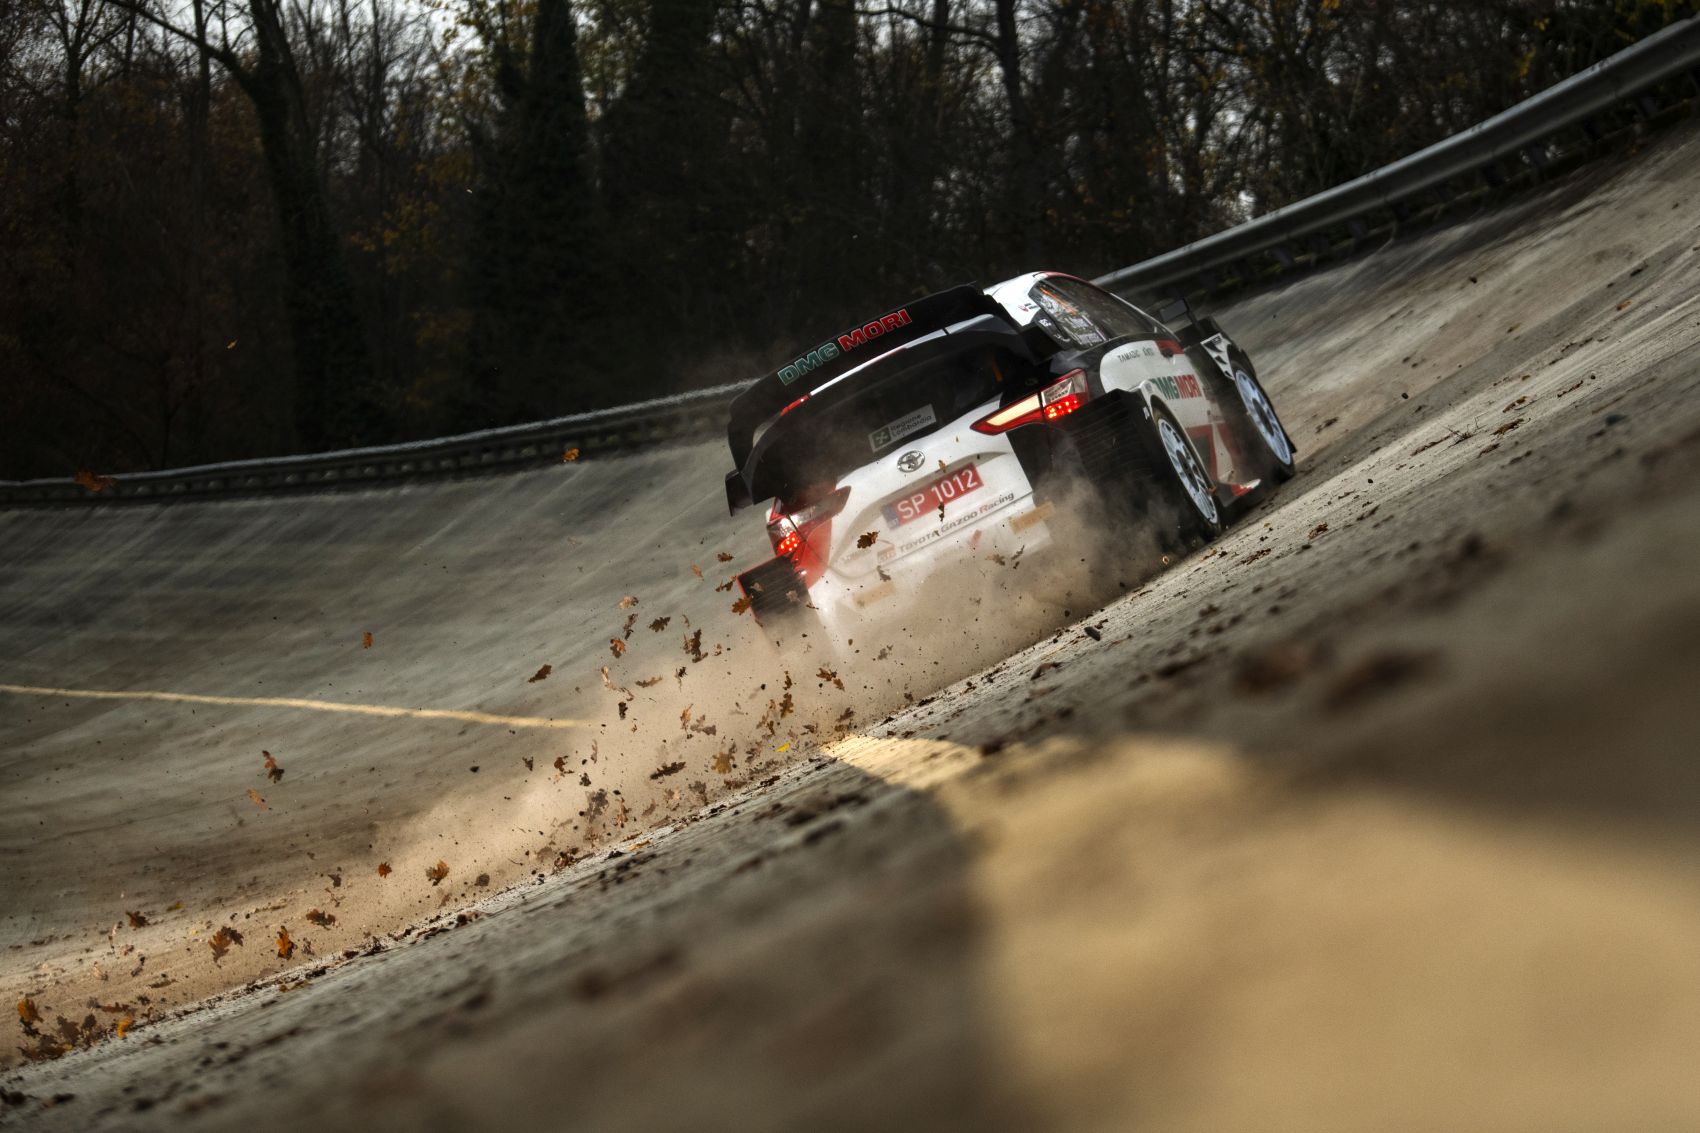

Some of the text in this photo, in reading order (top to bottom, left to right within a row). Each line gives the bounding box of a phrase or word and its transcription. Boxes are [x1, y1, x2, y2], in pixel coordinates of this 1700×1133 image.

[777, 308, 913, 386] DMG MORI
[897, 469, 978, 520] SP 1012
[978, 492, 1015, 514] Racing
